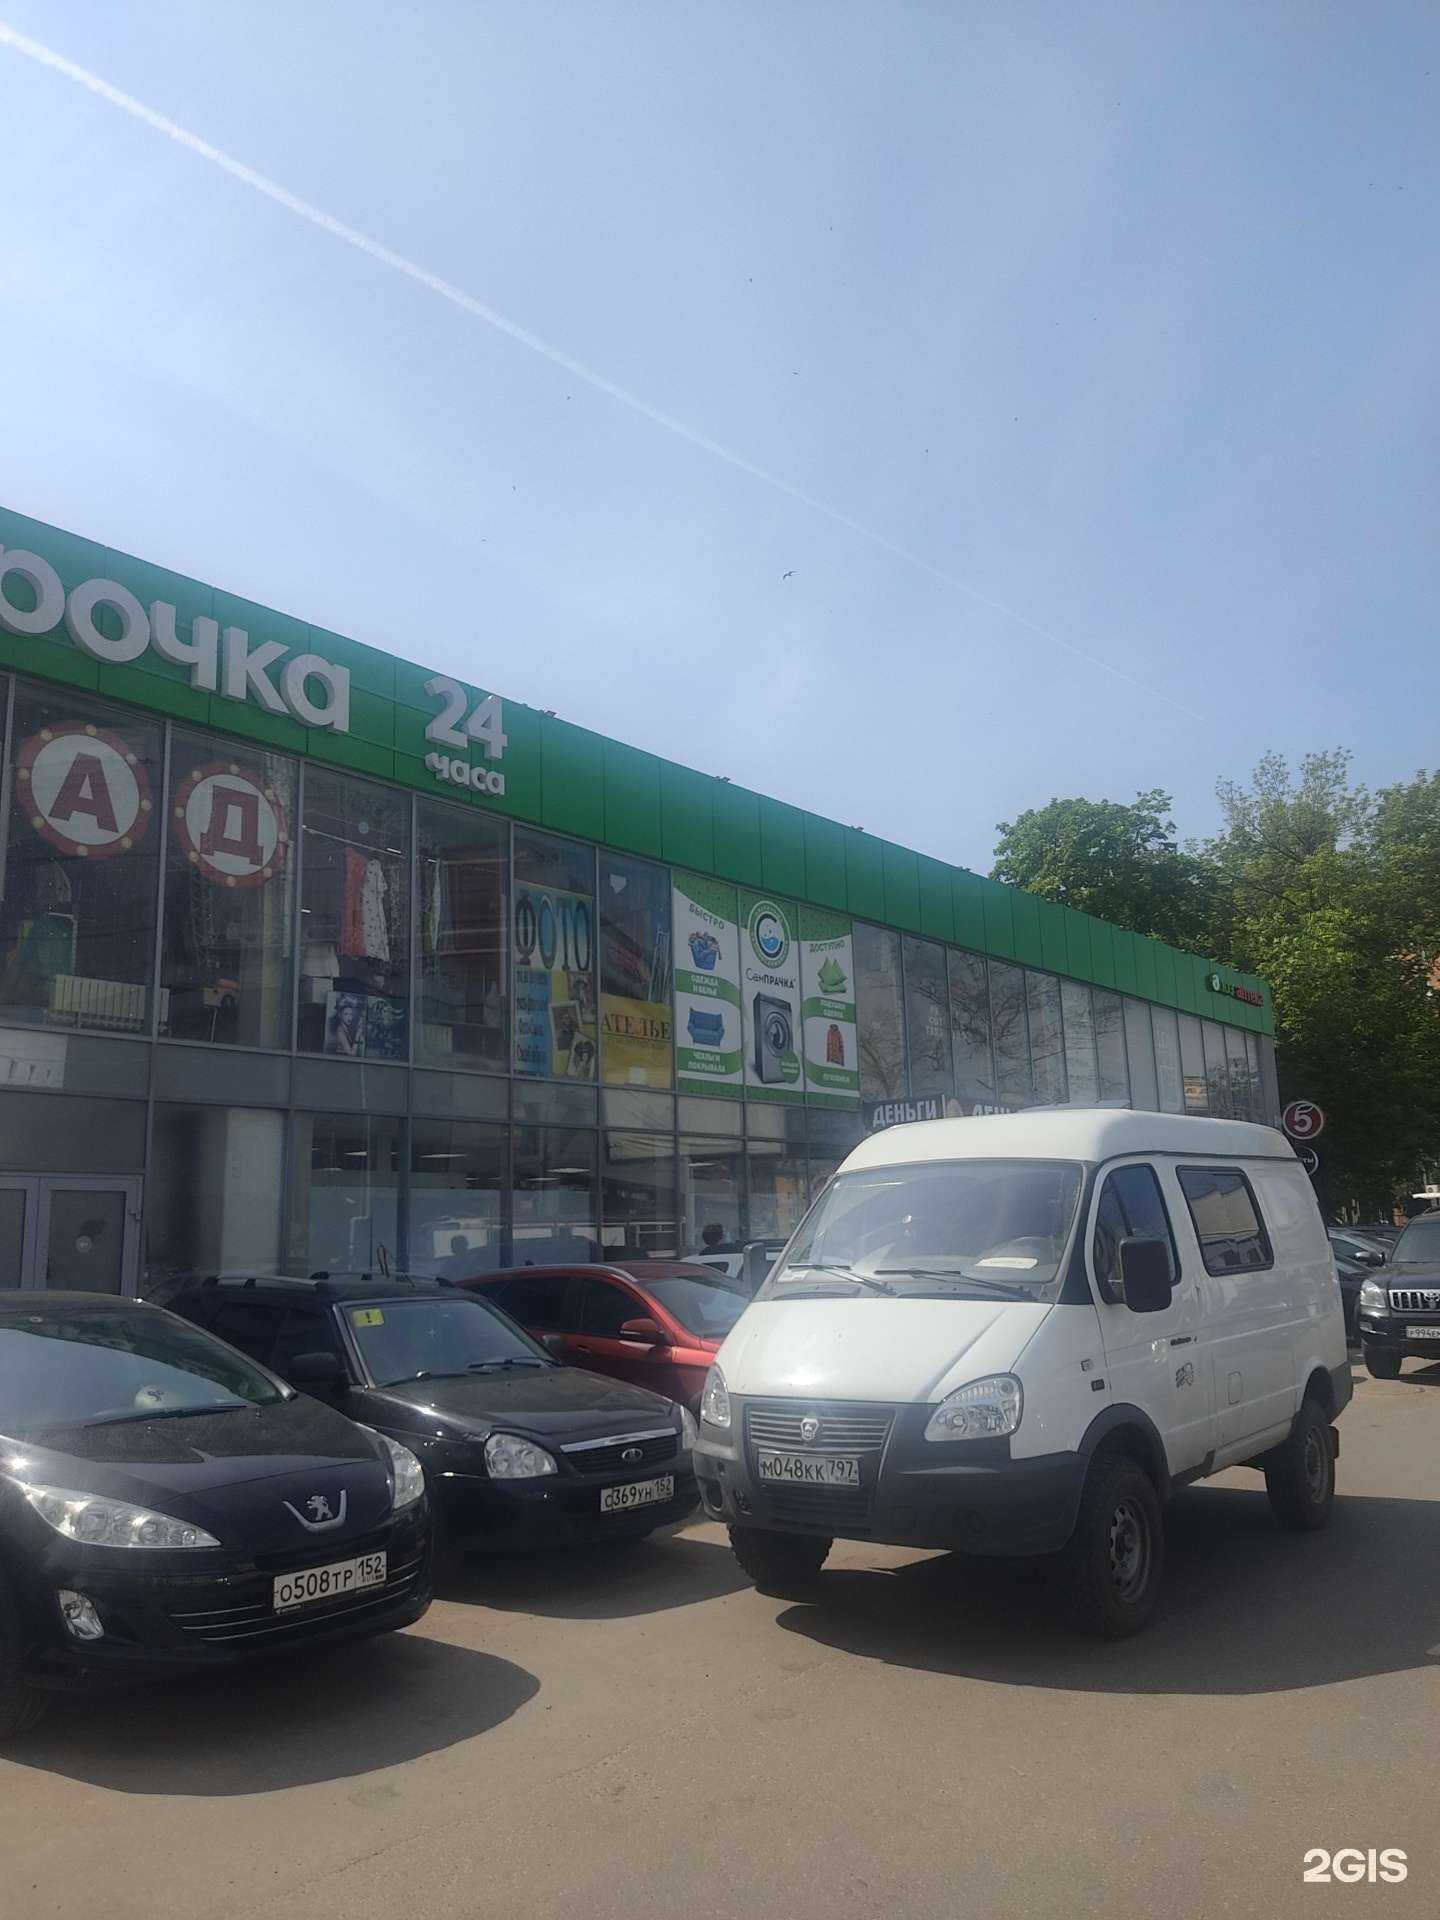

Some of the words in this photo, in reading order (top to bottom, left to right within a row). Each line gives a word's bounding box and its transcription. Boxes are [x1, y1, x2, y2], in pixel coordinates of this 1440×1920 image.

[424, 675, 507, 760] 24
[425, 753, 505, 795] часа
[515, 890, 591, 971] ФОТО
[689, 903, 725, 930] БЫСТРО
[602, 1012, 671, 1040] АТЕЛЬЕ
[872, 1098, 937, 1128] ДЕНЬГИ
[828, 1460, 854, 1477] 797
[655, 1478, 671, 1493] 152
[358, 1555, 382, 1577] 152
